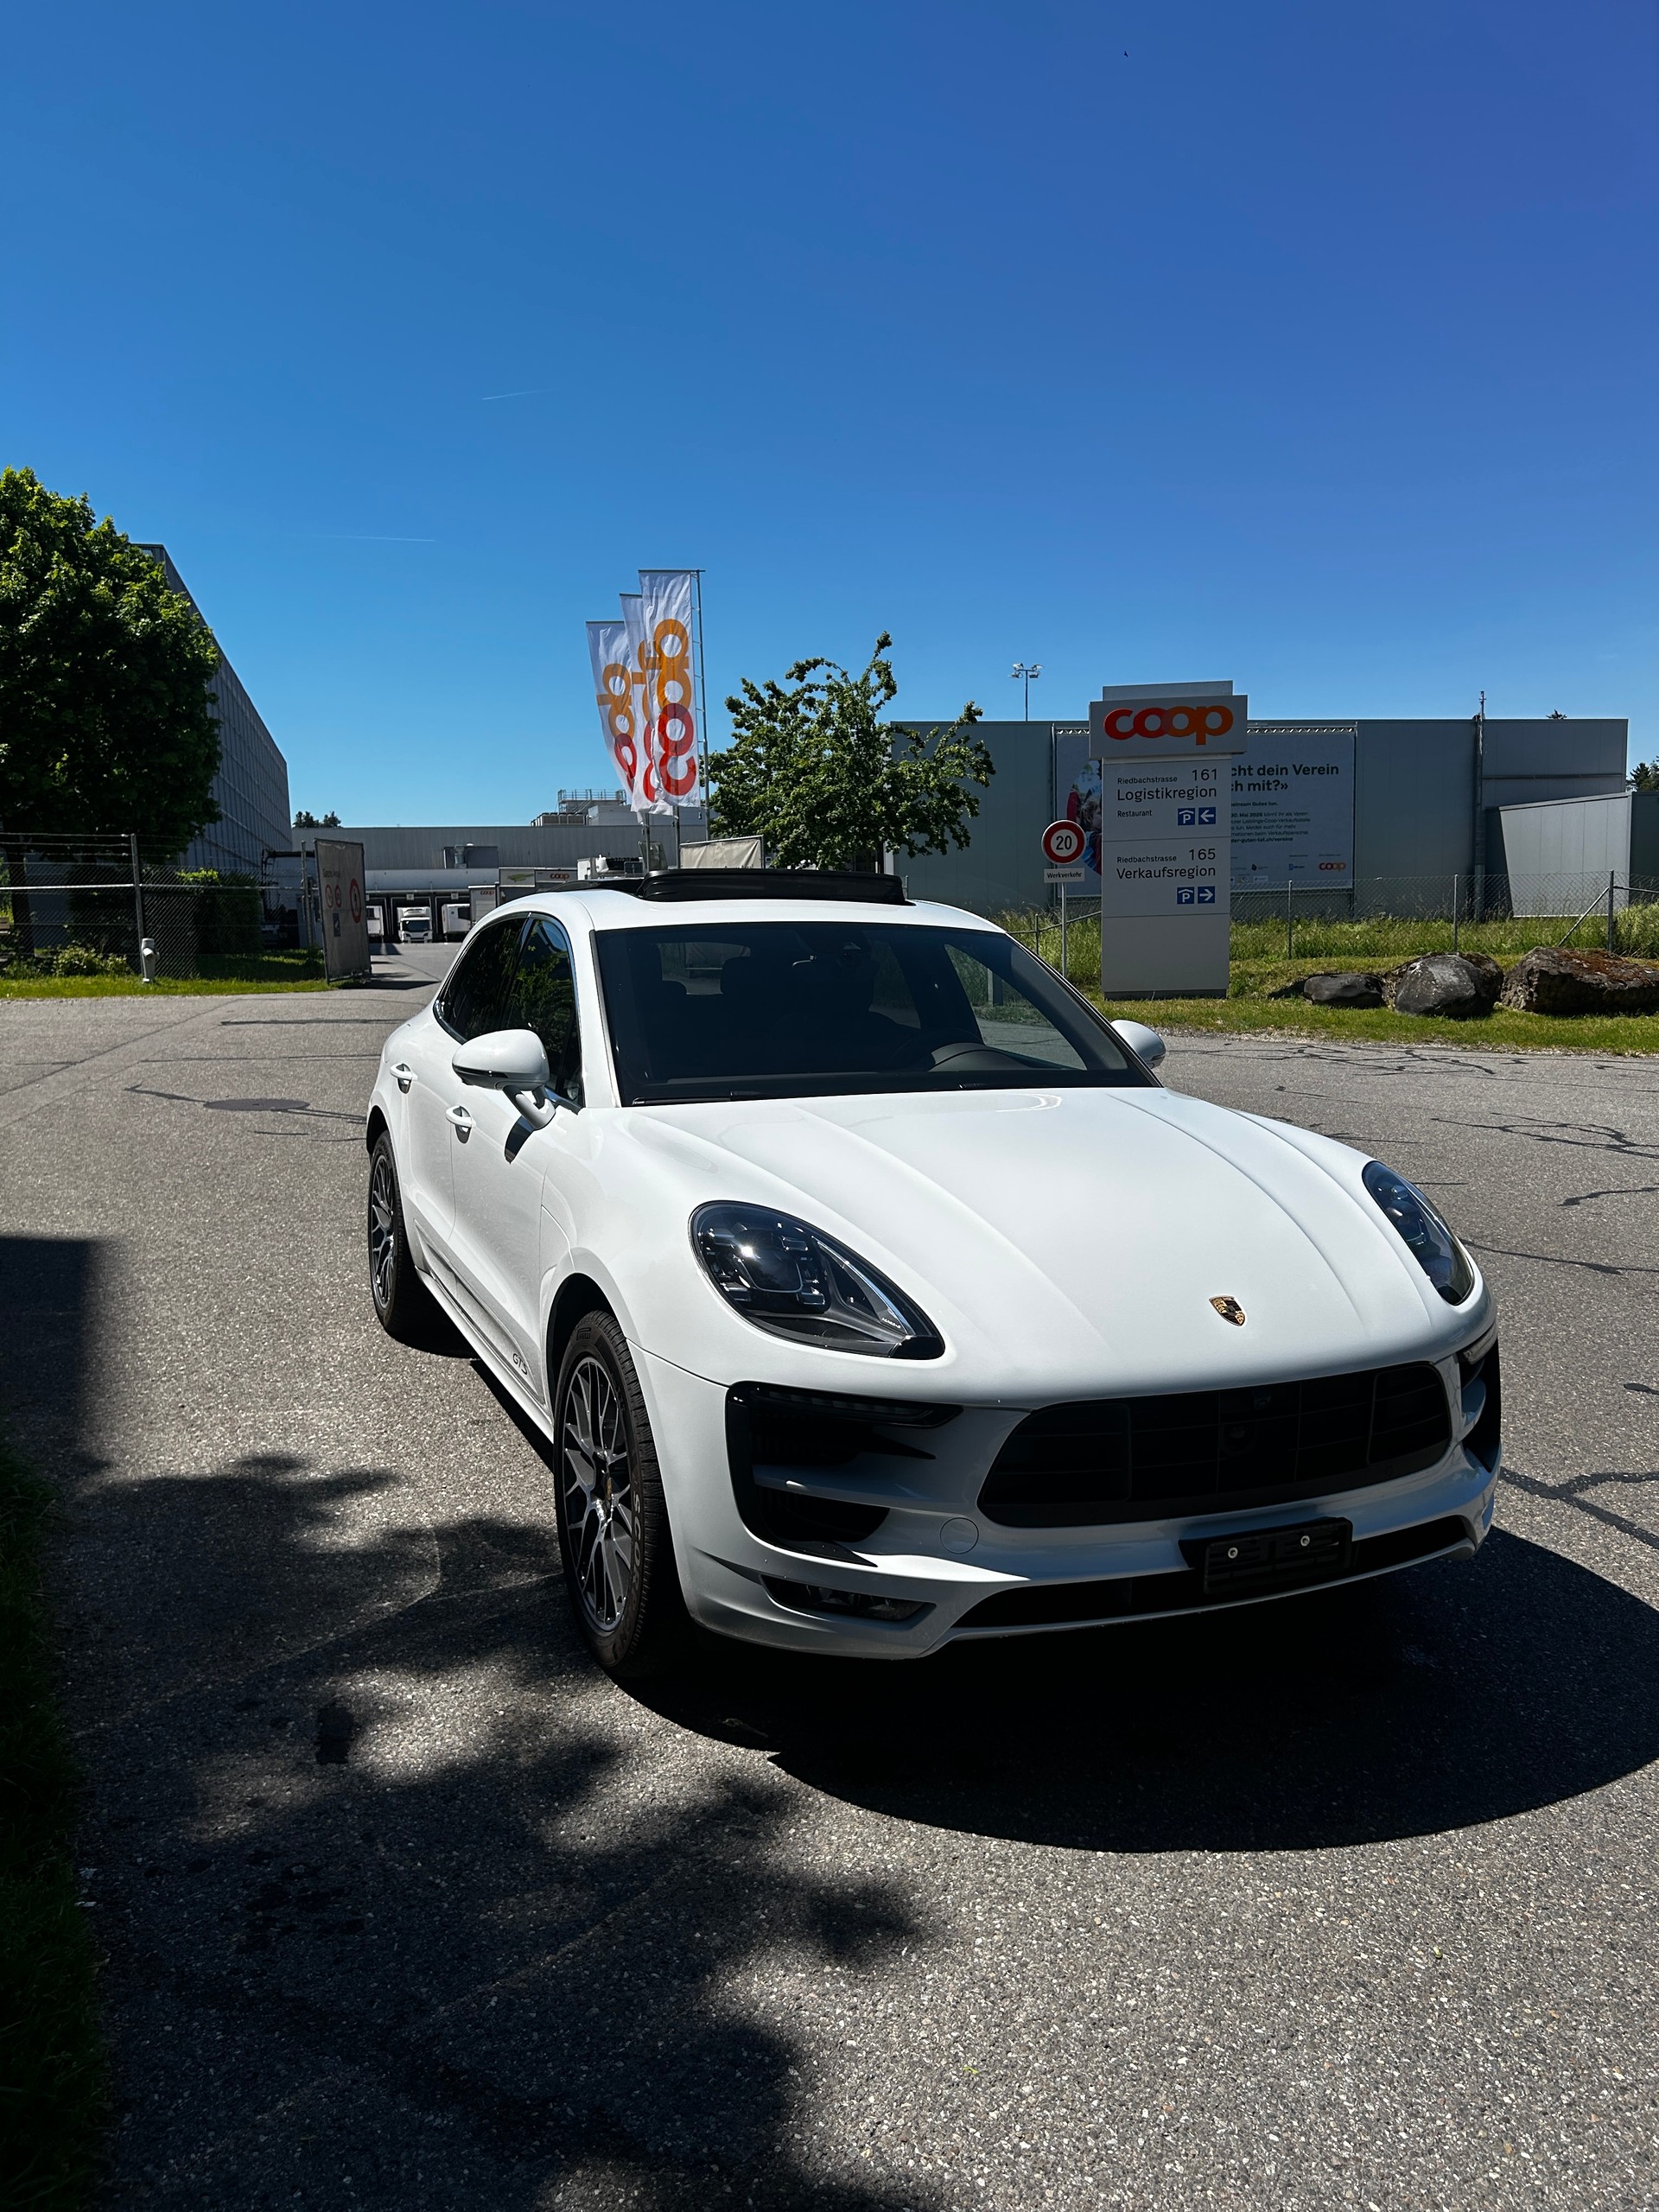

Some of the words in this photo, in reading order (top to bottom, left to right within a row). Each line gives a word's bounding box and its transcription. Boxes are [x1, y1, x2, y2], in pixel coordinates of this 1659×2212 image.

[645, 619, 696, 796] coop
[1103, 705, 1234, 746] coop
[1117, 776, 1178, 785] Riedbachstrasse
[1192, 768, 1217, 781] 161
[1257, 764, 1288, 776] dein
[1292, 763, 1339, 775] Verein
[1117, 785, 1217, 803] Logistikregion
[1056, 836, 1072, 850] 20
[1189, 848, 1216, 861] 165
[1116, 866, 1216, 880] Verkaufsregion
[1319, 862, 1346, 871] coop
[512, 1353, 528, 1376] GTS
